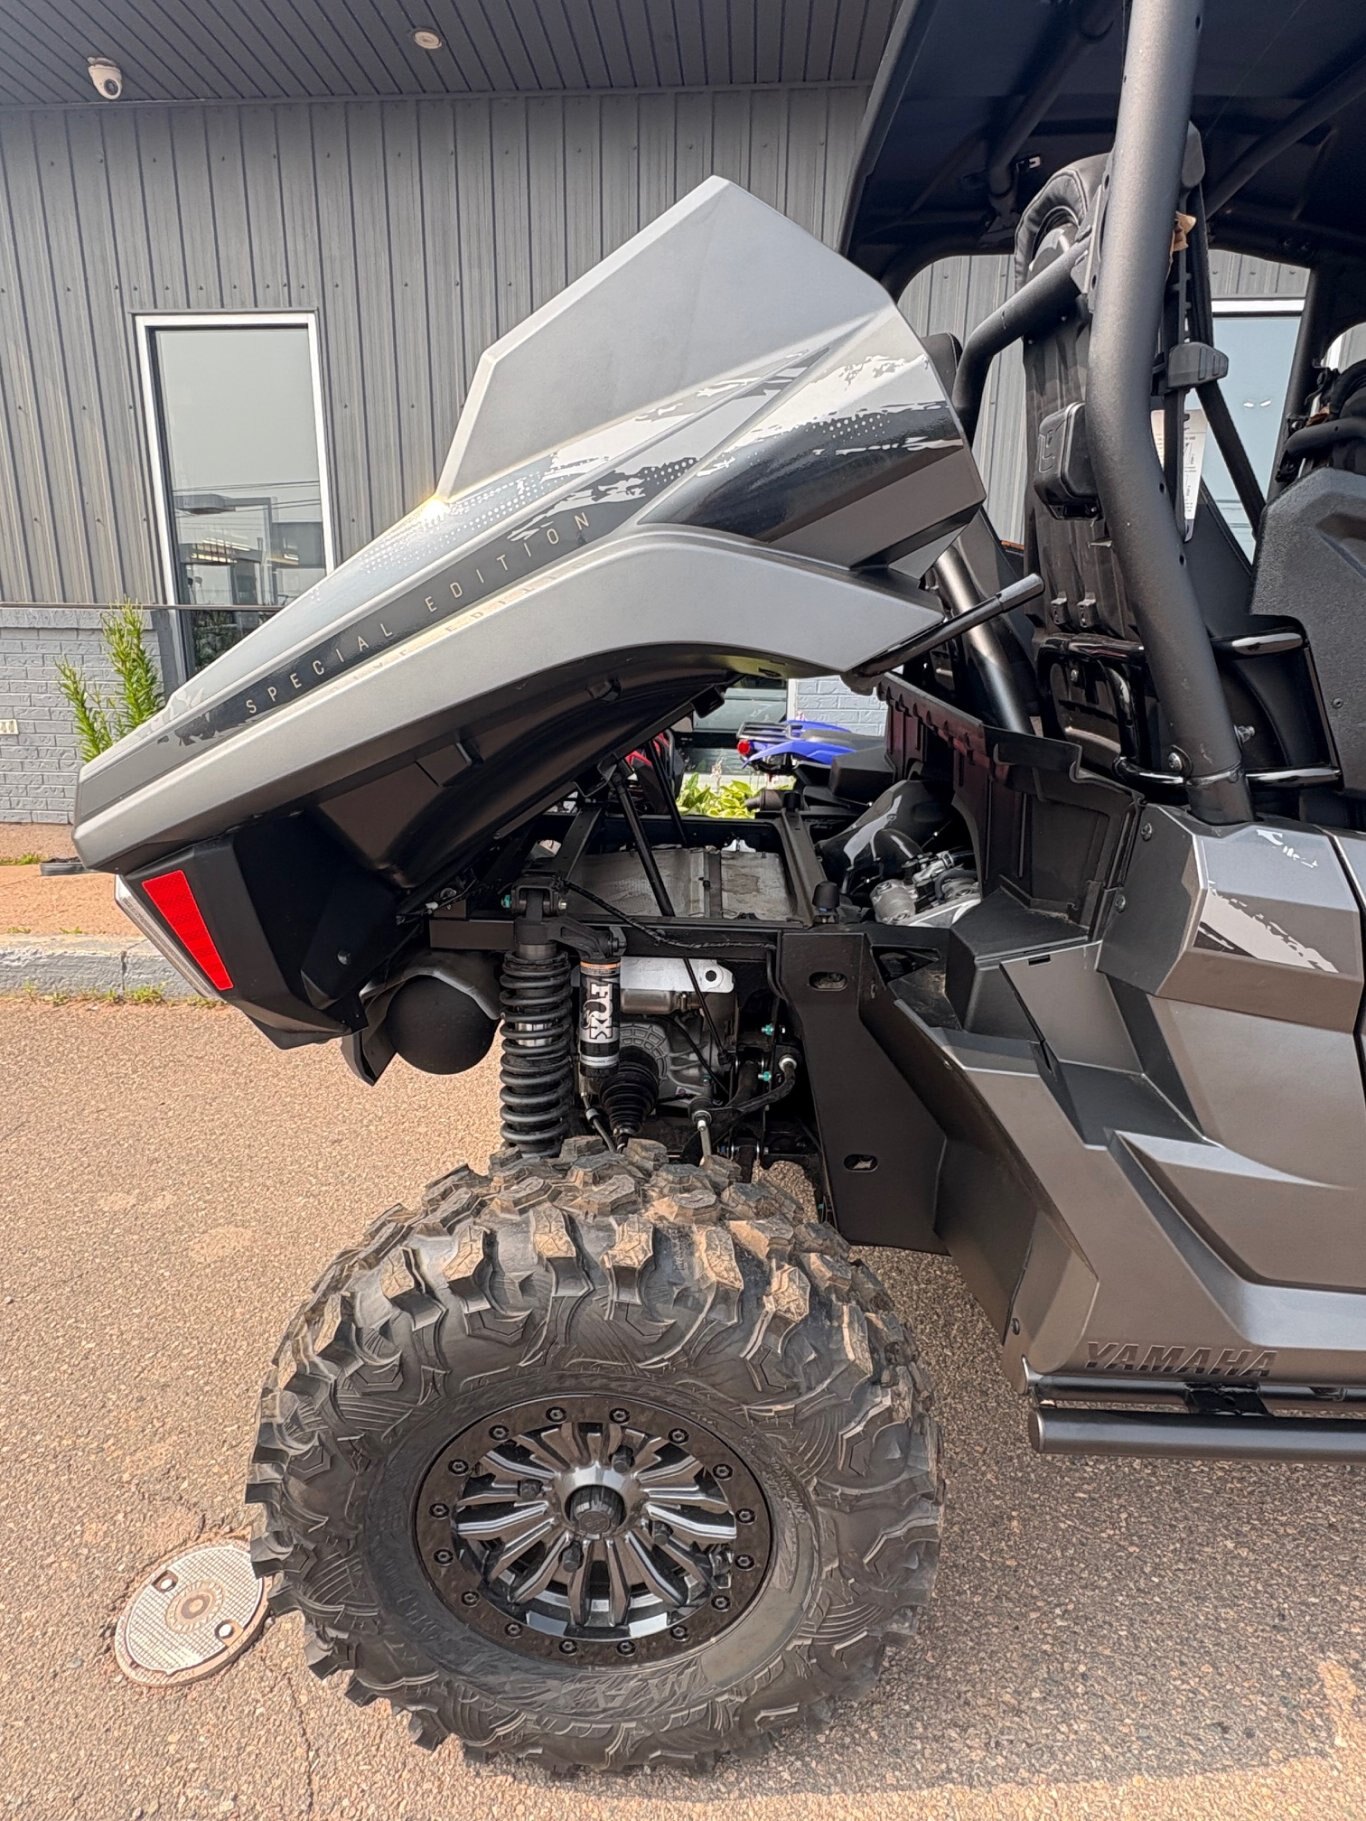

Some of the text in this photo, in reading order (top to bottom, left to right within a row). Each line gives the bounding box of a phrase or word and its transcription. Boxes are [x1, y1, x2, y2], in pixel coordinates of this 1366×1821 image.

[245, 511, 590, 715] SPECIAL EDITION
[583, 982, 614, 1040] FOX
[1085, 1341, 1278, 1377] YAMAHA
